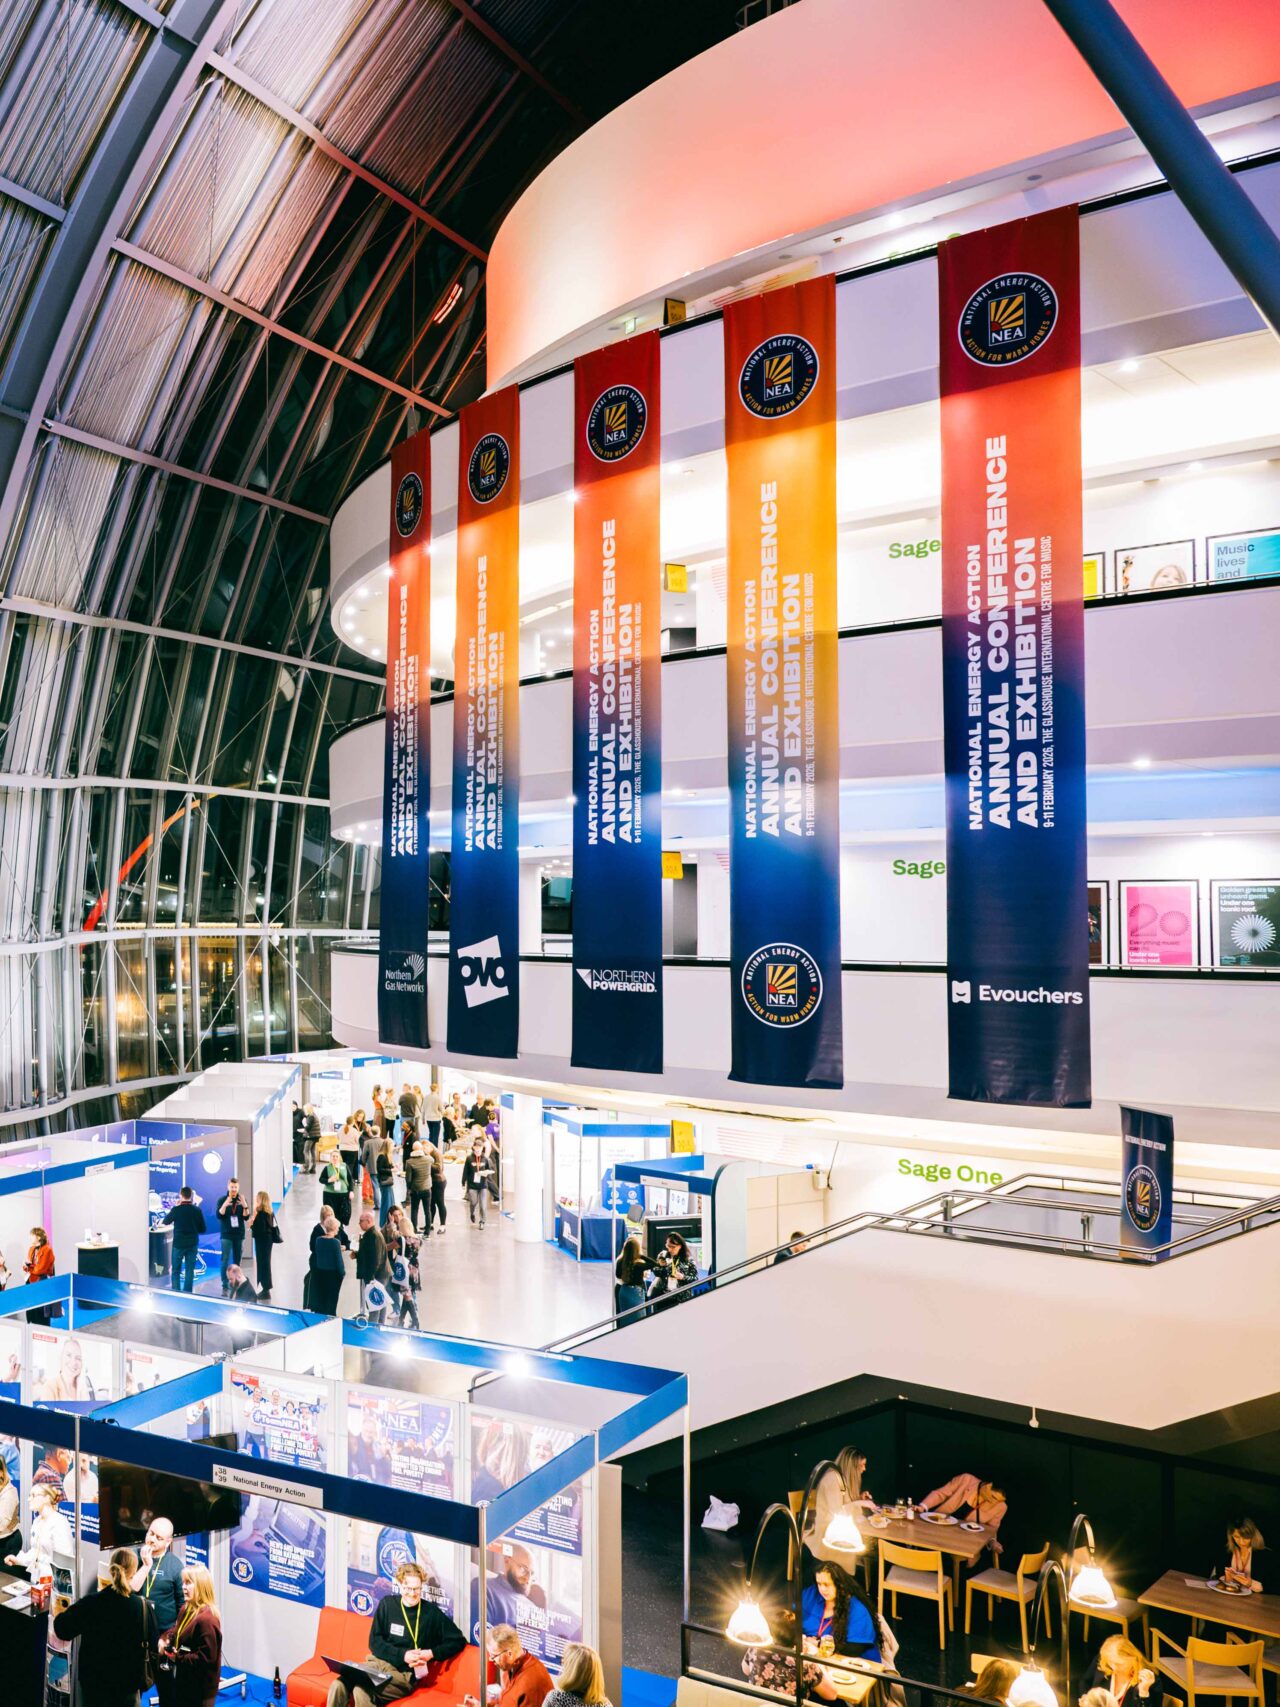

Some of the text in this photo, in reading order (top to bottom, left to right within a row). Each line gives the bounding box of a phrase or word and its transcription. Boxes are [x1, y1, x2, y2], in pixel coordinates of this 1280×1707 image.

[964, 277, 1052, 325] NATIONAL ENERGY ACTION
[966, 320, 1051, 361] ACTION FOR WARM HOMES
[991, 326, 1023, 343] NEA
[743, 338, 814, 381] NATIONAL ENERGY ACTION
[766, 383, 791, 398] NEA
[606, 429, 626, 443] NEA
[481, 474, 495, 485] NEA
[888, 539, 942, 559] Sage
[1216, 543, 1255, 556] Music
[1216, 556, 1246, 568] lives
[1217, 568, 1241, 580] and
[804, 598, 814, 612] FOR
[804, 614, 814, 641] CENTRE
[986, 434, 1011, 829] ANNUAL CONFERENCE
[760, 480, 779, 838] ANNUAL CONFERENCE
[804, 643, 815, 697] INTERNATIONAL
[601, 518, 616, 844] ANNUAL CONFERENCE
[967, 544, 983, 830] NATIONAL ENERGY ACTION
[1014, 537, 1038, 828] AND EXHIBITION
[1040, 535, 1055, 828] 9-11 FEBRUARY 2026, THE GLASSHOUSE INTERNATIONAL CENTRE FOR MUSIC
[475, 555, 487, 850] ANNUAL CONFERENCE
[744, 579, 757, 838] NATIONAL ENERGY ACTION
[783, 573, 802, 837] AND EXHIBITION
[398, 584, 408, 856] ANNUAL CONFERENCE
[588, 609, 599, 845] NATIONAL ENERGY ACTION
[619, 603, 632, 843] AND EXHIBITION
[805, 699, 815, 745] GLASSHOUSE
[465, 637, 476, 851] NATIONAL ENERGY ACTION
[487, 631, 498, 850] AND EXHIBITION
[805, 746, 815, 760] THE
[405, 655, 415, 855] AND EXHIBITION
[805, 762, 816, 782] 2026,
[805, 784, 815, 821] FEBRUARY
[805, 821, 815, 836] 9-11
[892, 859, 946, 879] Sage
[385, 969, 412, 980] Northern
[592, 968, 656, 983] NORTHERN
[746, 947, 817, 983] NATIONAL ENERGY ACTION
[385, 980, 424, 993] Gas Networks
[769, 993, 795, 1005] NEA
[979, 984, 1083, 1005] Evouchers
[747, 993, 816, 1023] ACTION FOR WARM HOMES
[898, 1159, 1003, 1185] Sage One
[1136, 1203, 1149, 1214] NEA
[387, 1413, 419, 1431] NEA
[218, 1467, 227, 1475] 38
[218, 1475, 227, 1483] 39
[233, 1475, 306, 1498] National Energy Action
